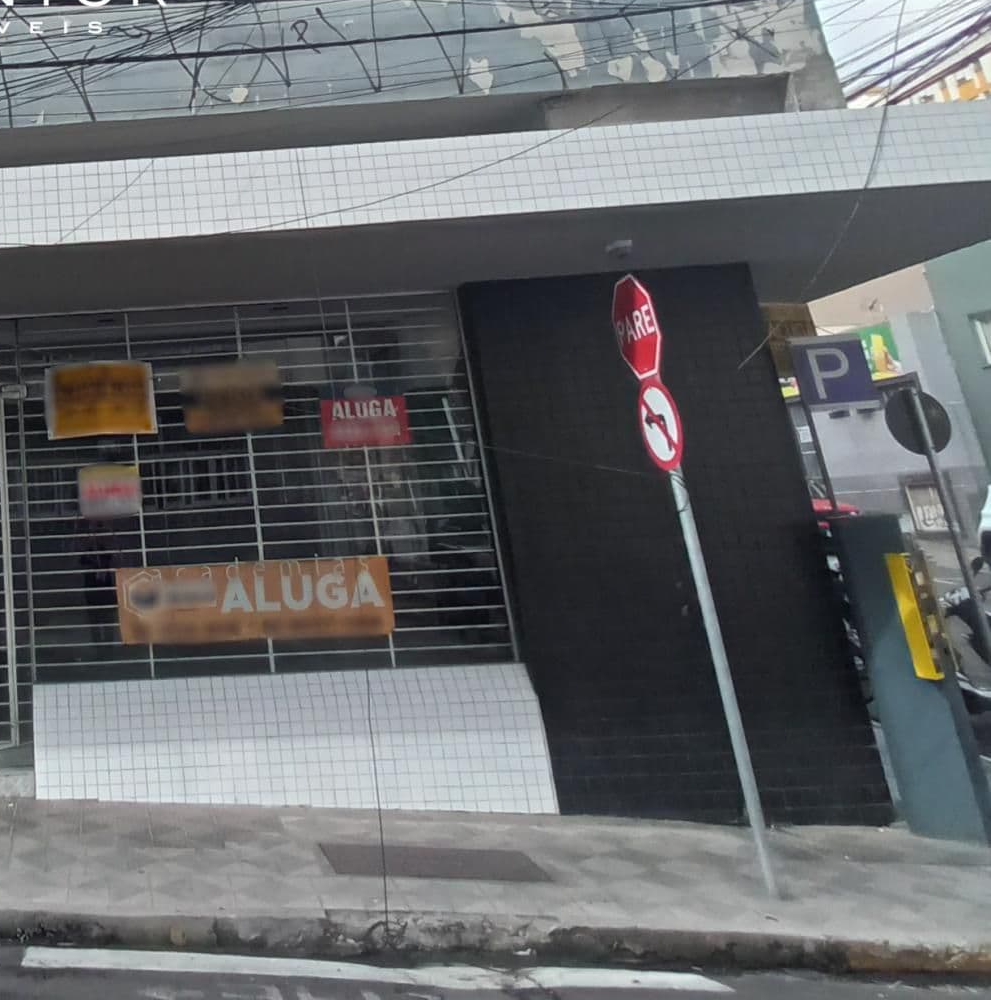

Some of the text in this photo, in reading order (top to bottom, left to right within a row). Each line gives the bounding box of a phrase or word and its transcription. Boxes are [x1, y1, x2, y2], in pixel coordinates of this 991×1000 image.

[616, 304, 657, 346] PARE
[806, 348, 850, 399] P
[332, 399, 397, 420] ALUGA
[221, 570, 386, 613] ALUGA
